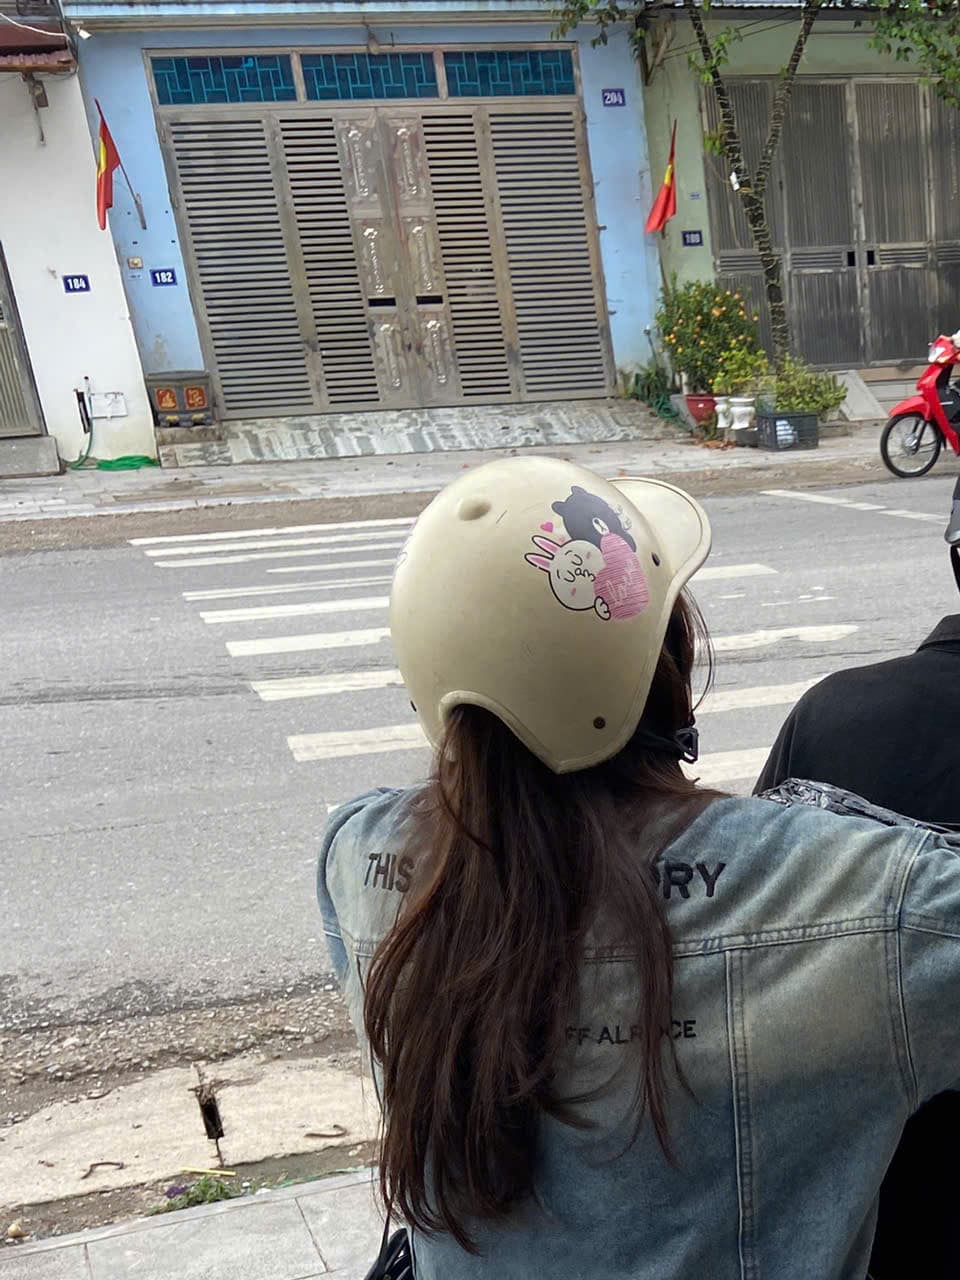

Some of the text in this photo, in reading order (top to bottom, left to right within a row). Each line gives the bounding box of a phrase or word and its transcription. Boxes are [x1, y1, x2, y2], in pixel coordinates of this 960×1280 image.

[66, 277, 87, 290] 184
[154, 271, 173, 284] 182
[363, 852, 414, 893] THIS
[653, 861, 726, 900] RY
